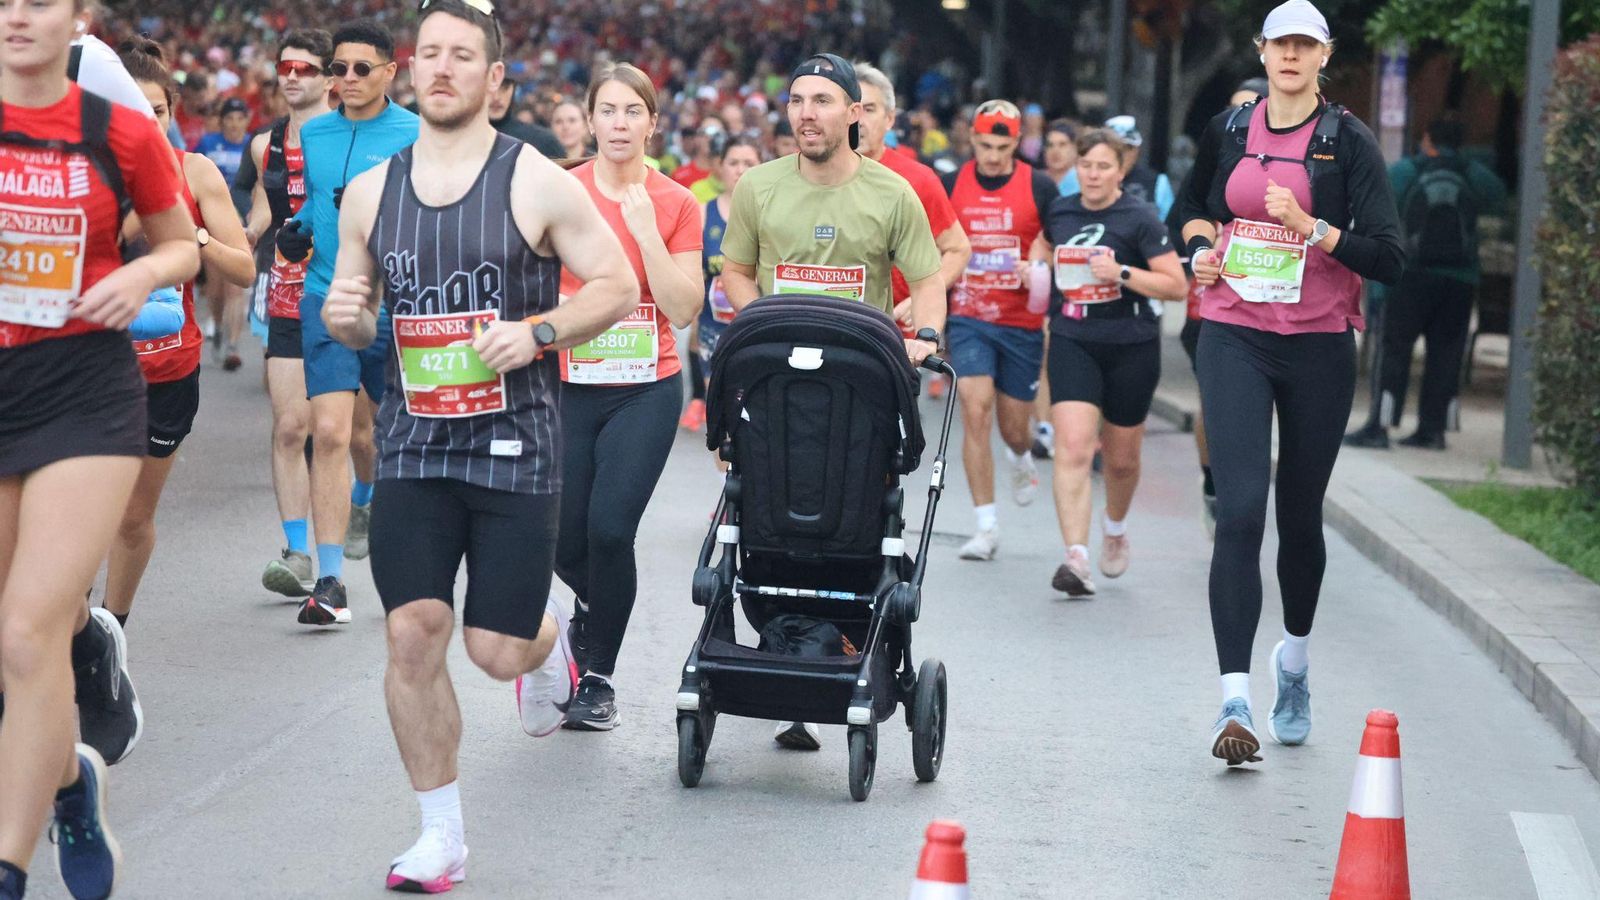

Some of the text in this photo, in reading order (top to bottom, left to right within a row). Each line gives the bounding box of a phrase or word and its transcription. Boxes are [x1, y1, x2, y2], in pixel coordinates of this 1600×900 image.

[0, 210, 75, 234] ENERALI
[1244, 225, 1299, 243] GENERALI
[1236, 250, 1286, 270] 15507
[800, 269, 858, 282] GENERALI
[420, 352, 468, 371] 4271
